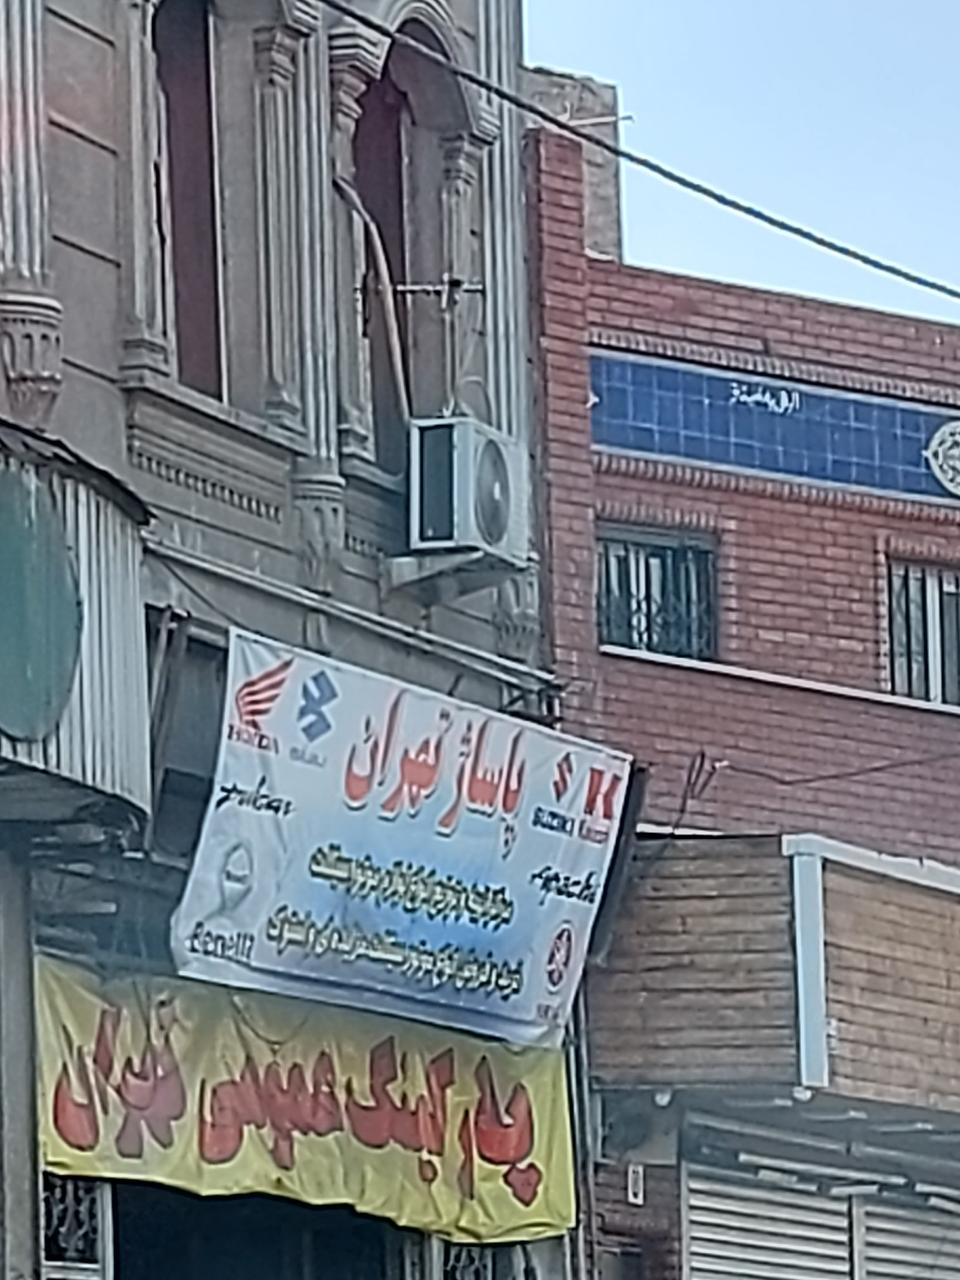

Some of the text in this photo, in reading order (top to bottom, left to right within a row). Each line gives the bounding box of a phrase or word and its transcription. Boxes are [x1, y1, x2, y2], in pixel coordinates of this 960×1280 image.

[344, 690, 527, 861] پاساژ تهران
[345, 1034, 542, 1207] پارکینگ
